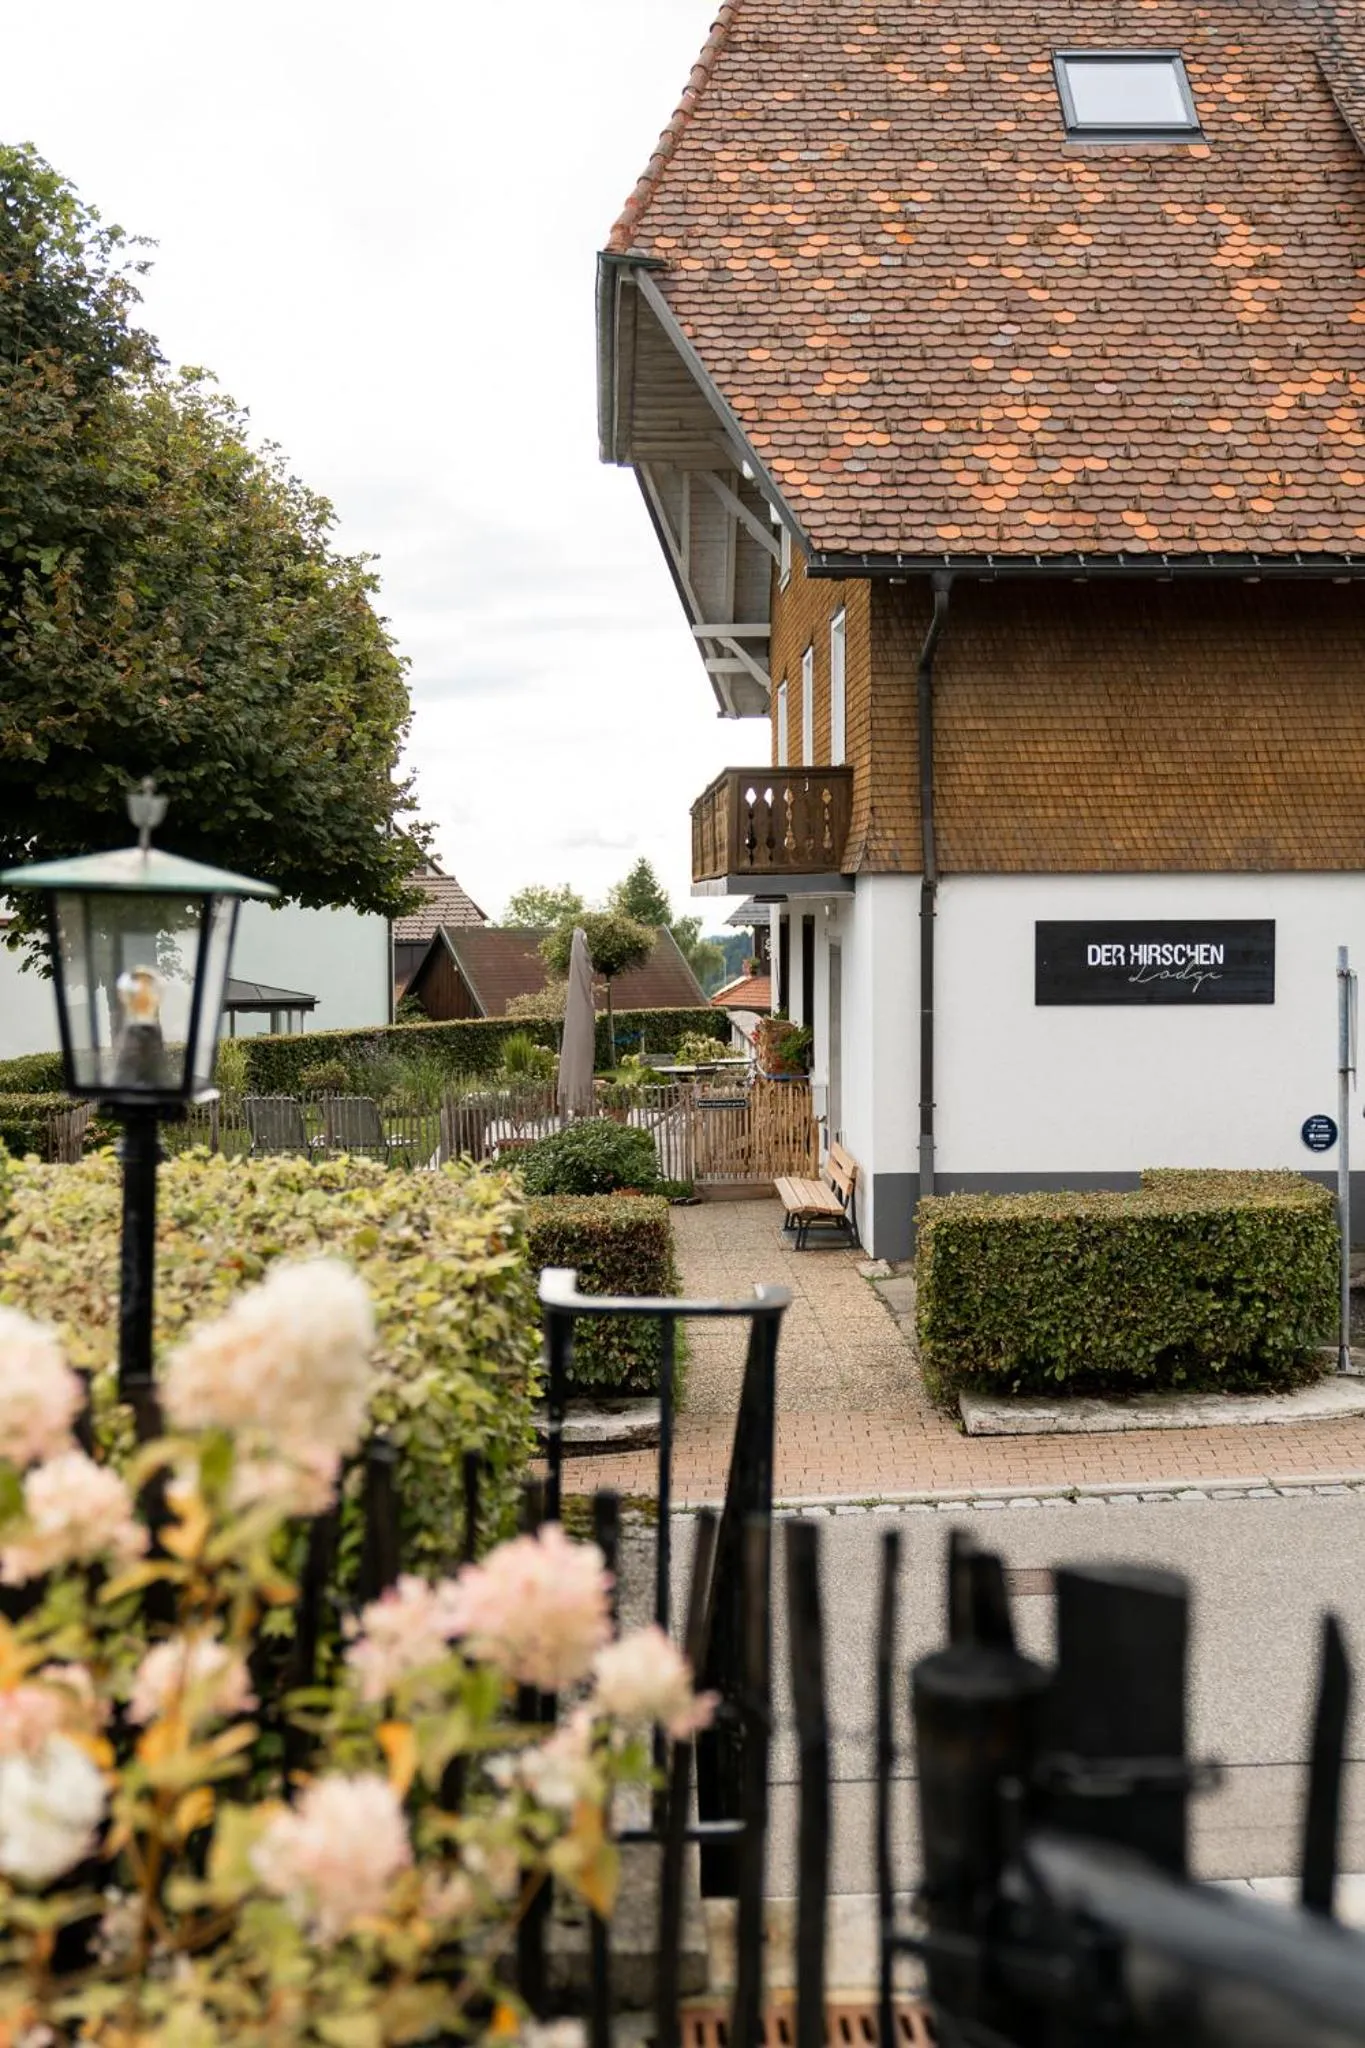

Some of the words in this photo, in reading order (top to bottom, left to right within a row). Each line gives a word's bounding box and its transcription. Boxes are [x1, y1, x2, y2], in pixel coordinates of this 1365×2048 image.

[1087, 944, 1126, 966] DER
[1129, 943, 1224, 965] HIRSCHEN
[1128, 958, 1223, 993] Lodge
